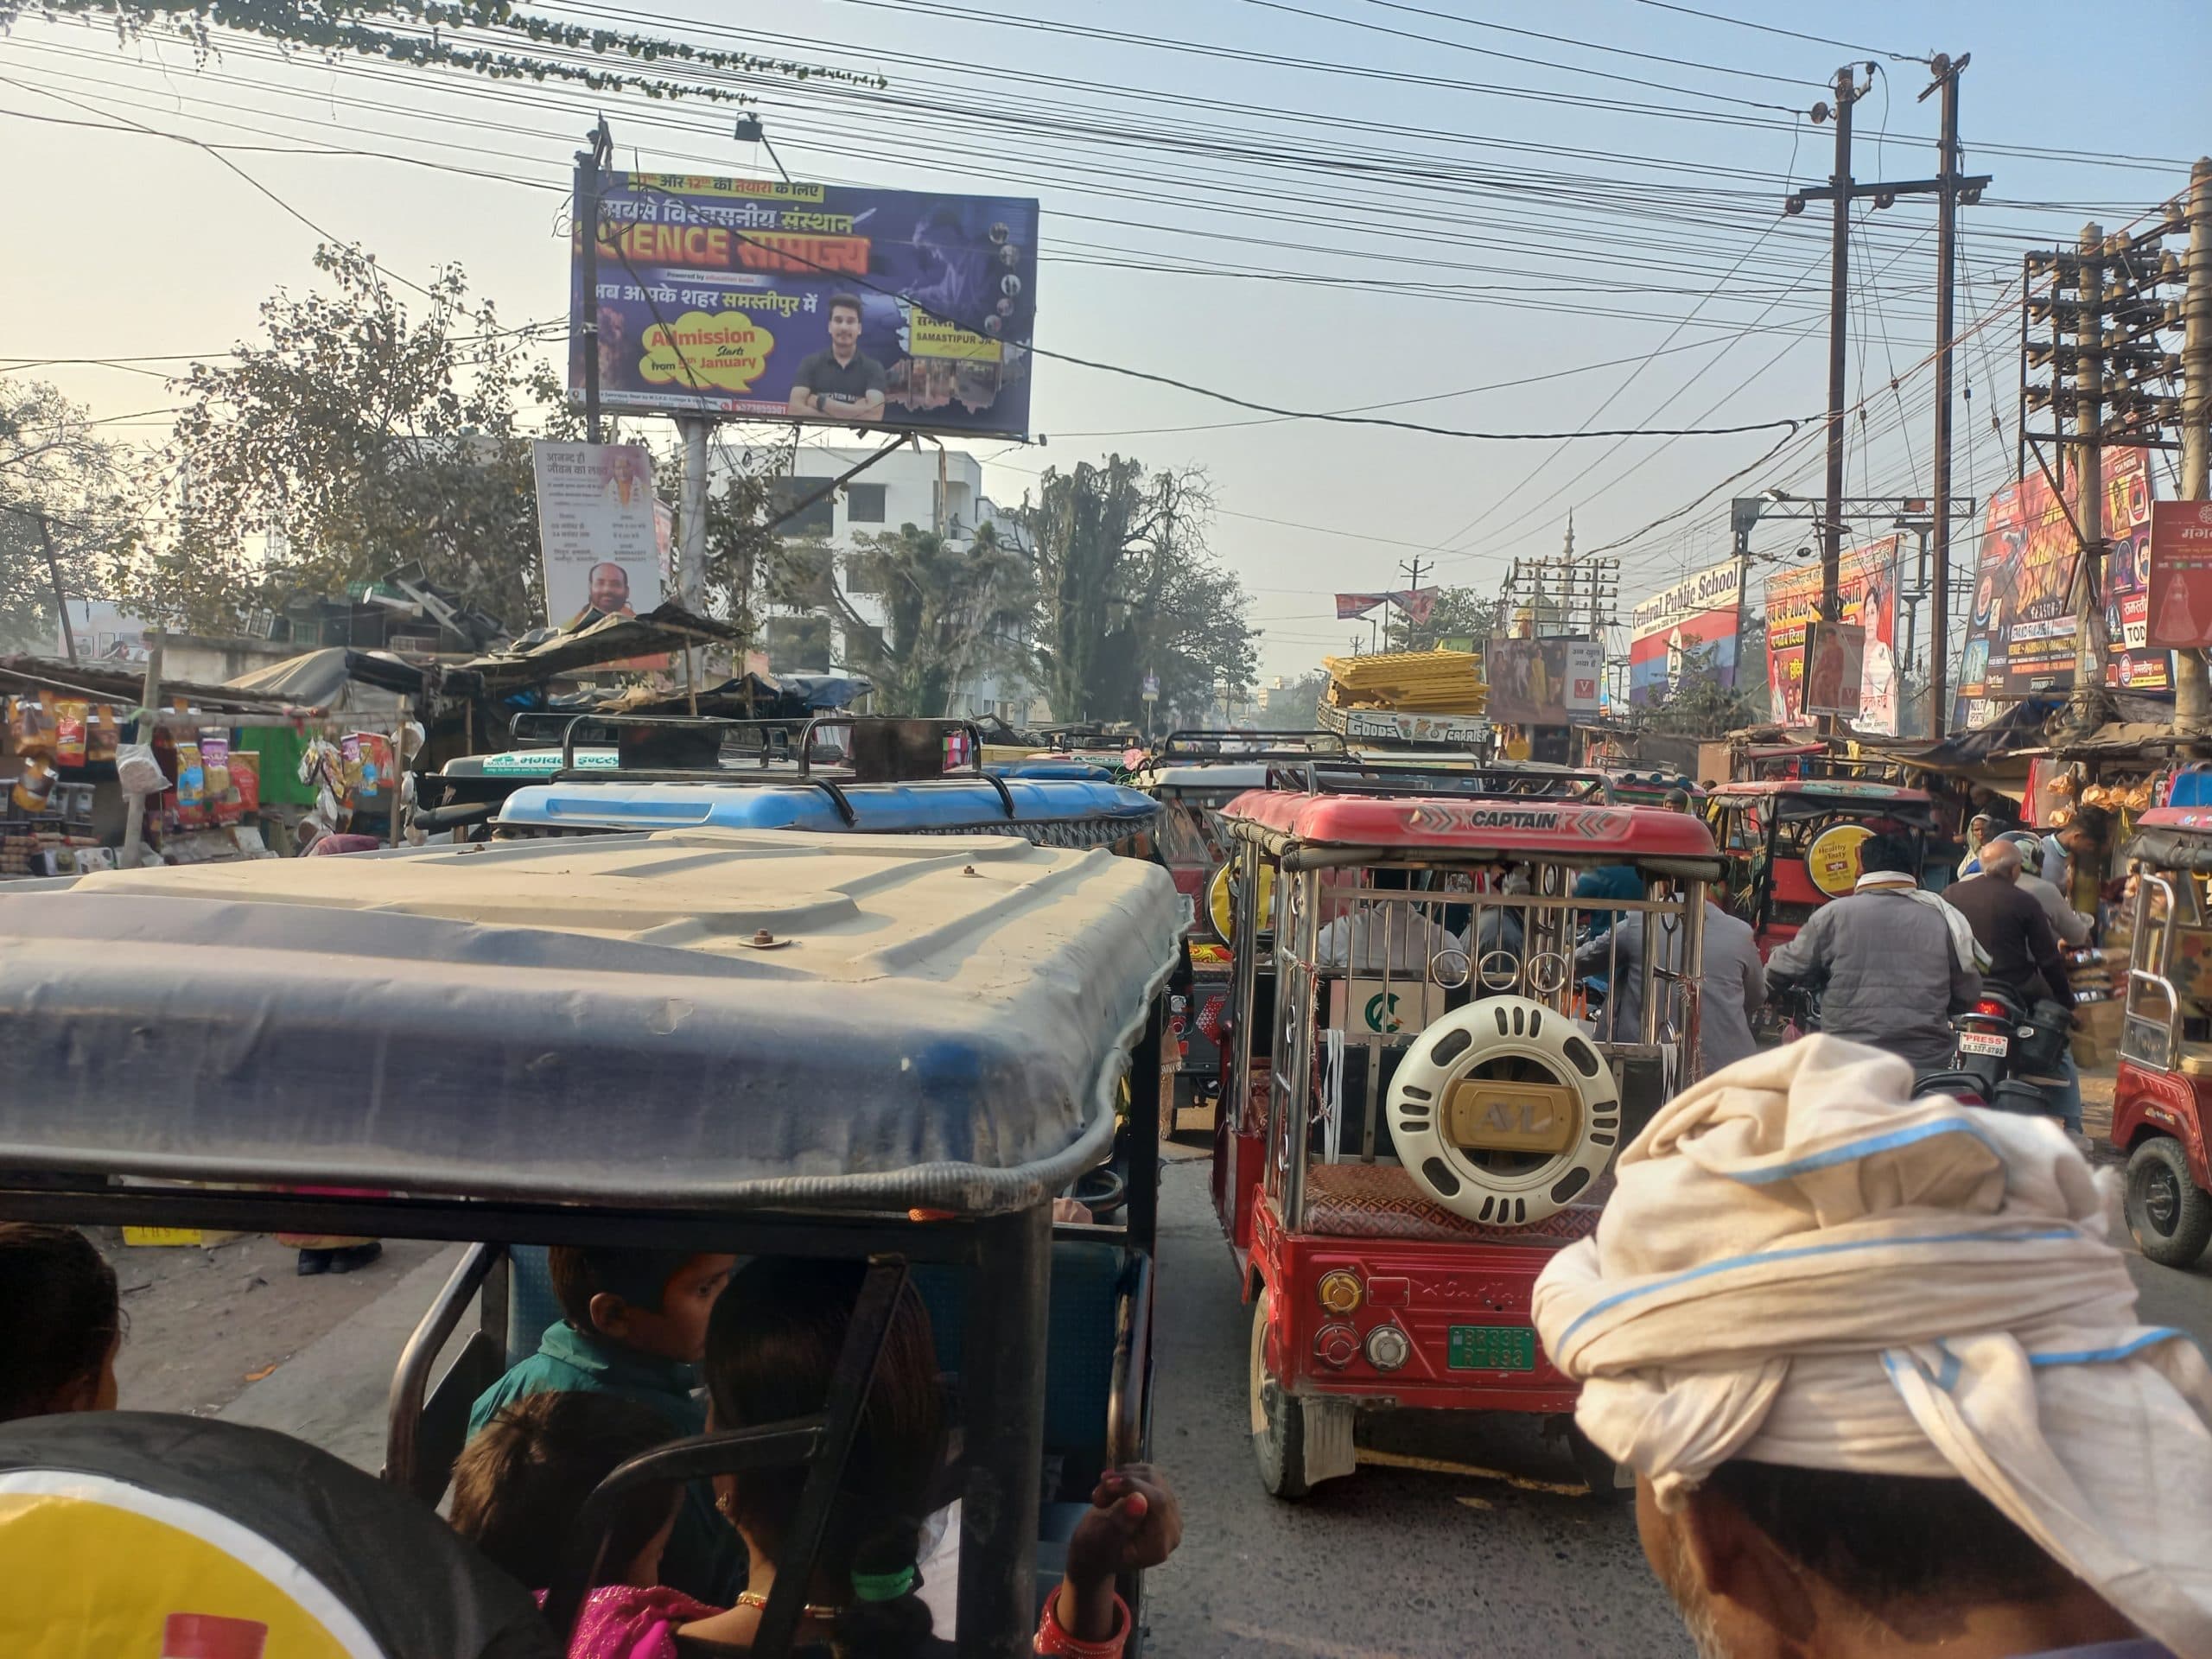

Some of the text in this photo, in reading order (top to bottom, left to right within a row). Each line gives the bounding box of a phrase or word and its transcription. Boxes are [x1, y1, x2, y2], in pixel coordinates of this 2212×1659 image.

[780, 205, 855, 234] संस्थान
[666, 271, 695, 281] Powered
[696, 272, 705, 283] by
[623, 283, 678, 303] आपके
[680, 289, 720, 308] शहर
[721, 290, 800, 317] समस्तीपुर
[802, 293, 819, 313] में
[651, 327, 755, 346] Admission
[916, 332, 976, 345] SAMASTIPUR
[715, 346, 744, 357] Starts
[651, 360, 676, 372] from
[699, 355, 757, 370] January
[1632, 596, 1663, 630] Central
[1665, 581, 1696, 616] Public
[1698, 562, 1738, 601] School
[1353, 721, 1489, 743] GOODS CARRIER
[1471, 810, 1560, 830] CAPTAIN
[1818, 843, 1847, 855] Healthy
[1827, 851, 1847, 860] Tasty
[1965, 1034, 2002, 1045] PRESS
